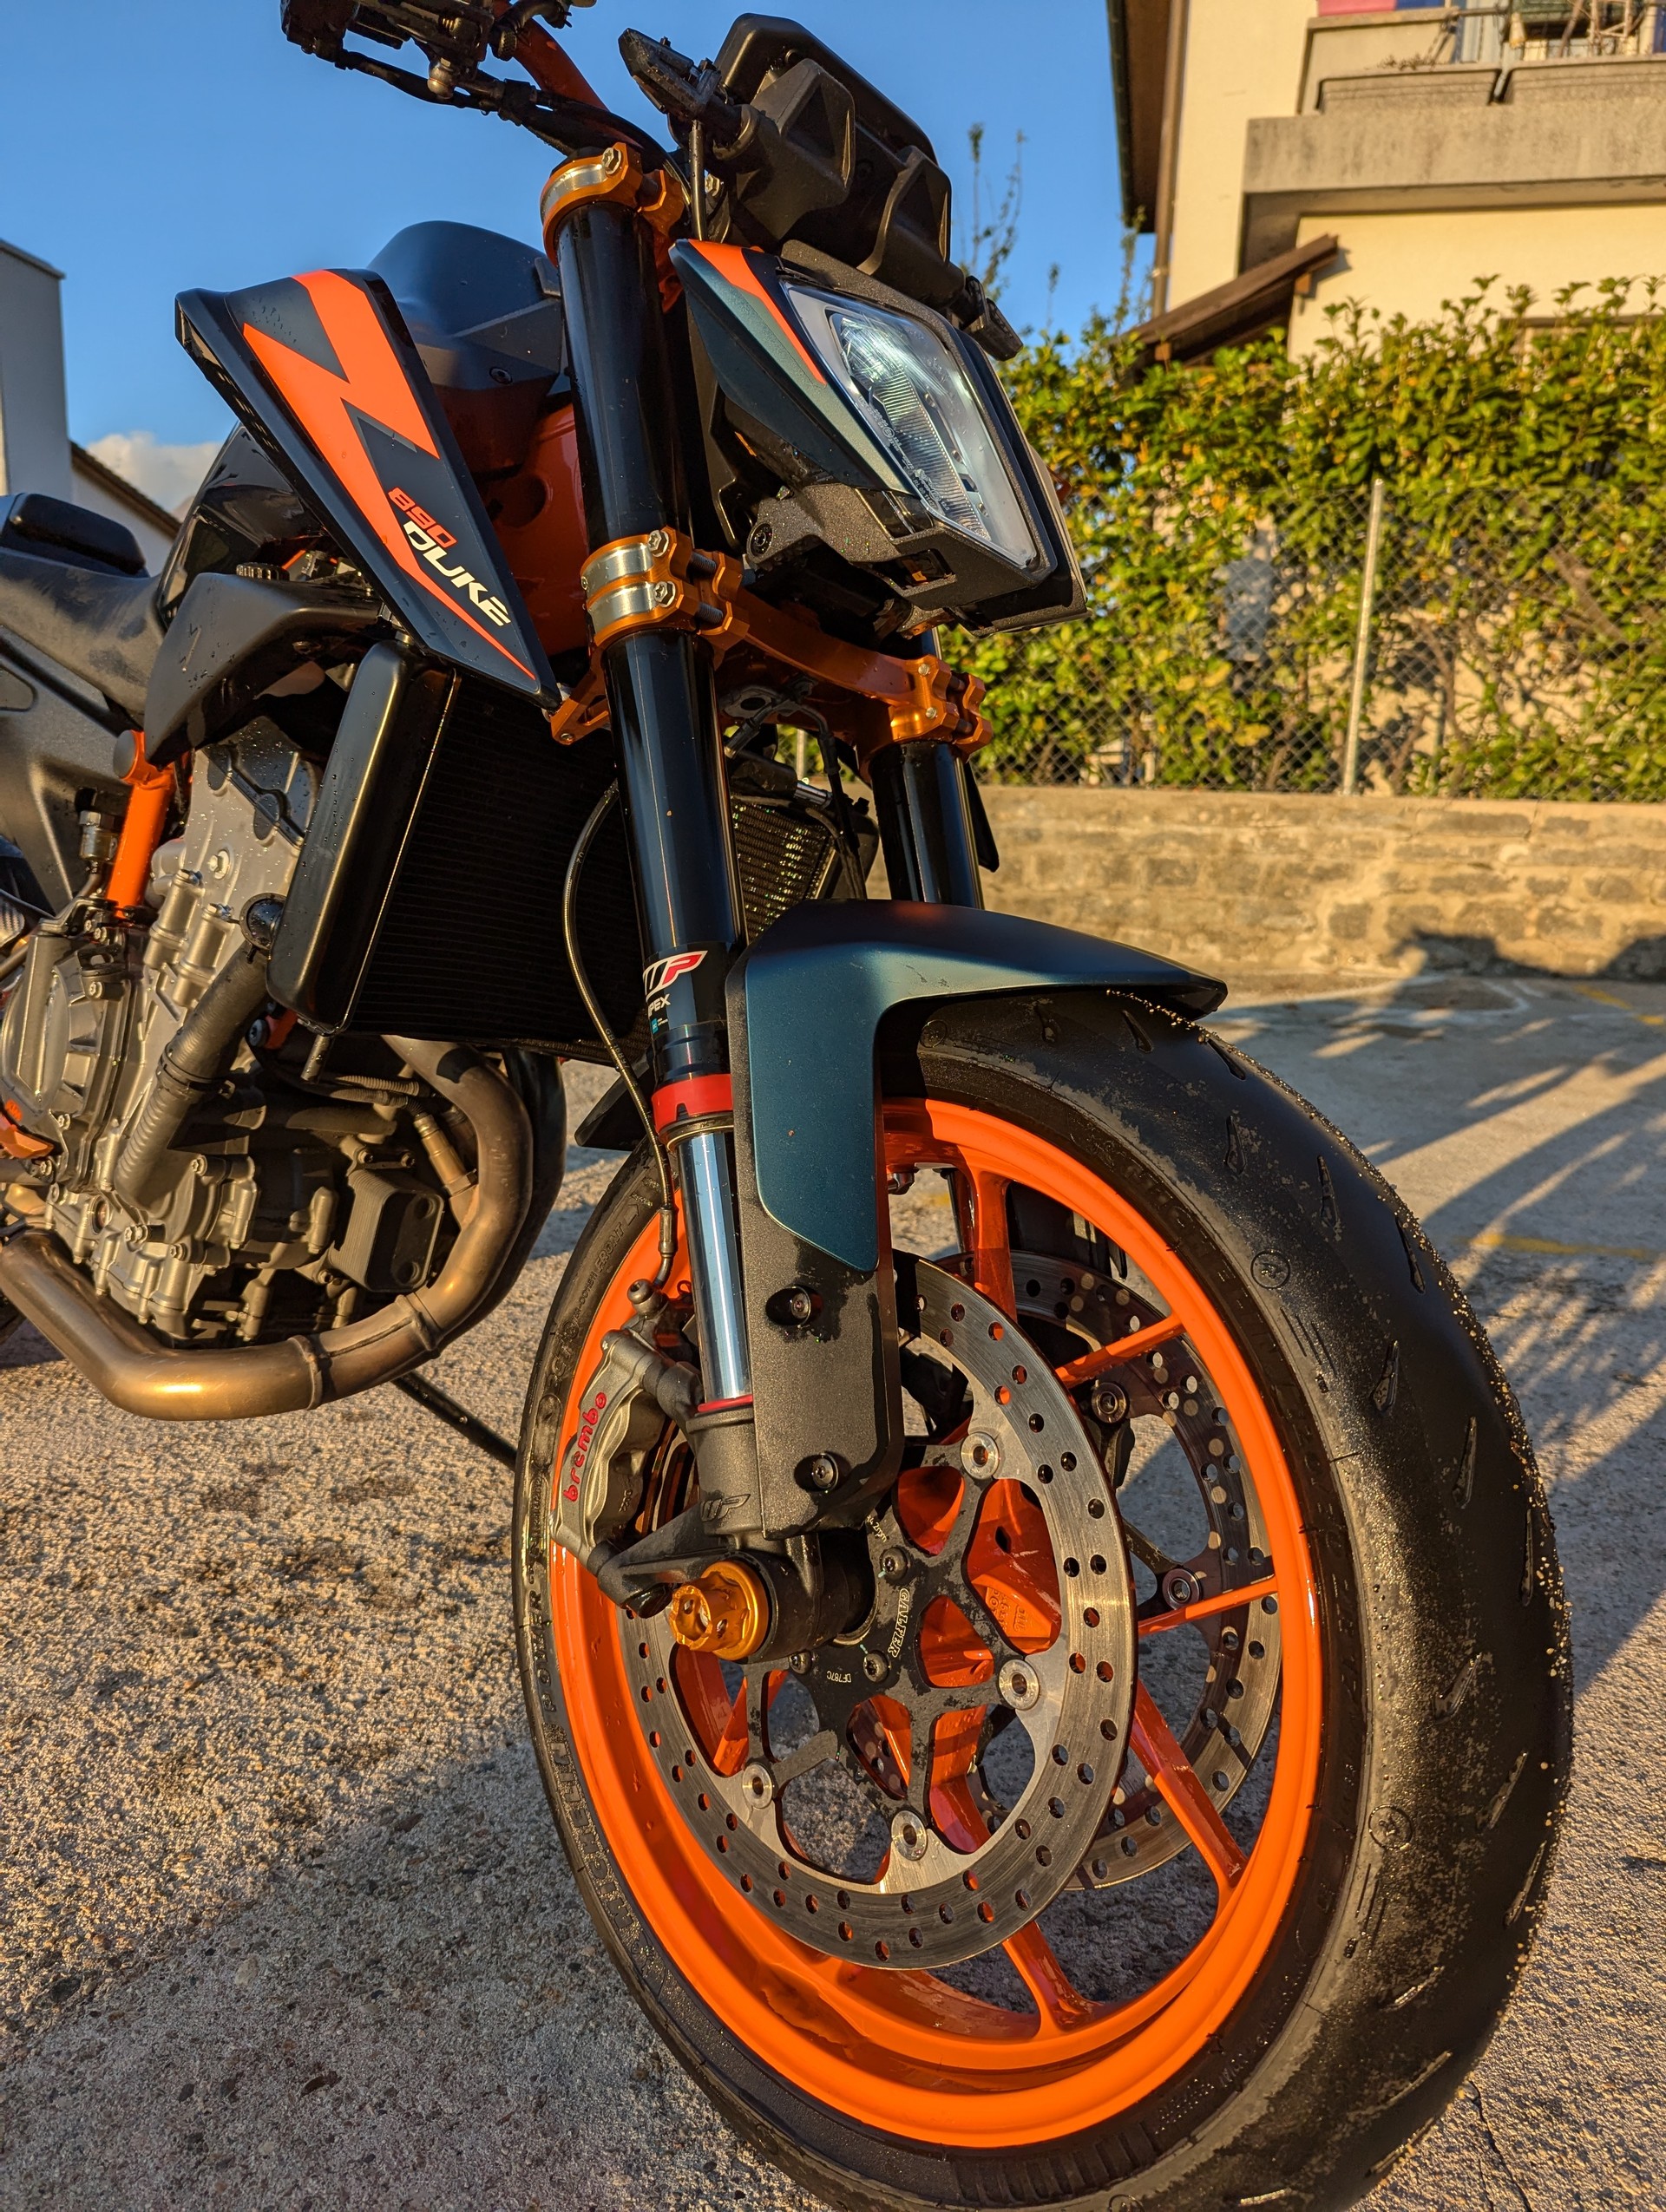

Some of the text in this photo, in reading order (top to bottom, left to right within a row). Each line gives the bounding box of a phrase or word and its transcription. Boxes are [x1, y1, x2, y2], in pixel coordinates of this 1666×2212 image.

[388, 487, 457, 548] 890
[403, 520, 511, 626] DUKE
[647, 993, 671, 1017] PEX
[563, 1391, 607, 1502] brembo
[887, 1587, 910, 1658] GALFER
[826, 1671, 852, 1683] DF787C
[550, 1742, 633, 1931] MICHELIN
